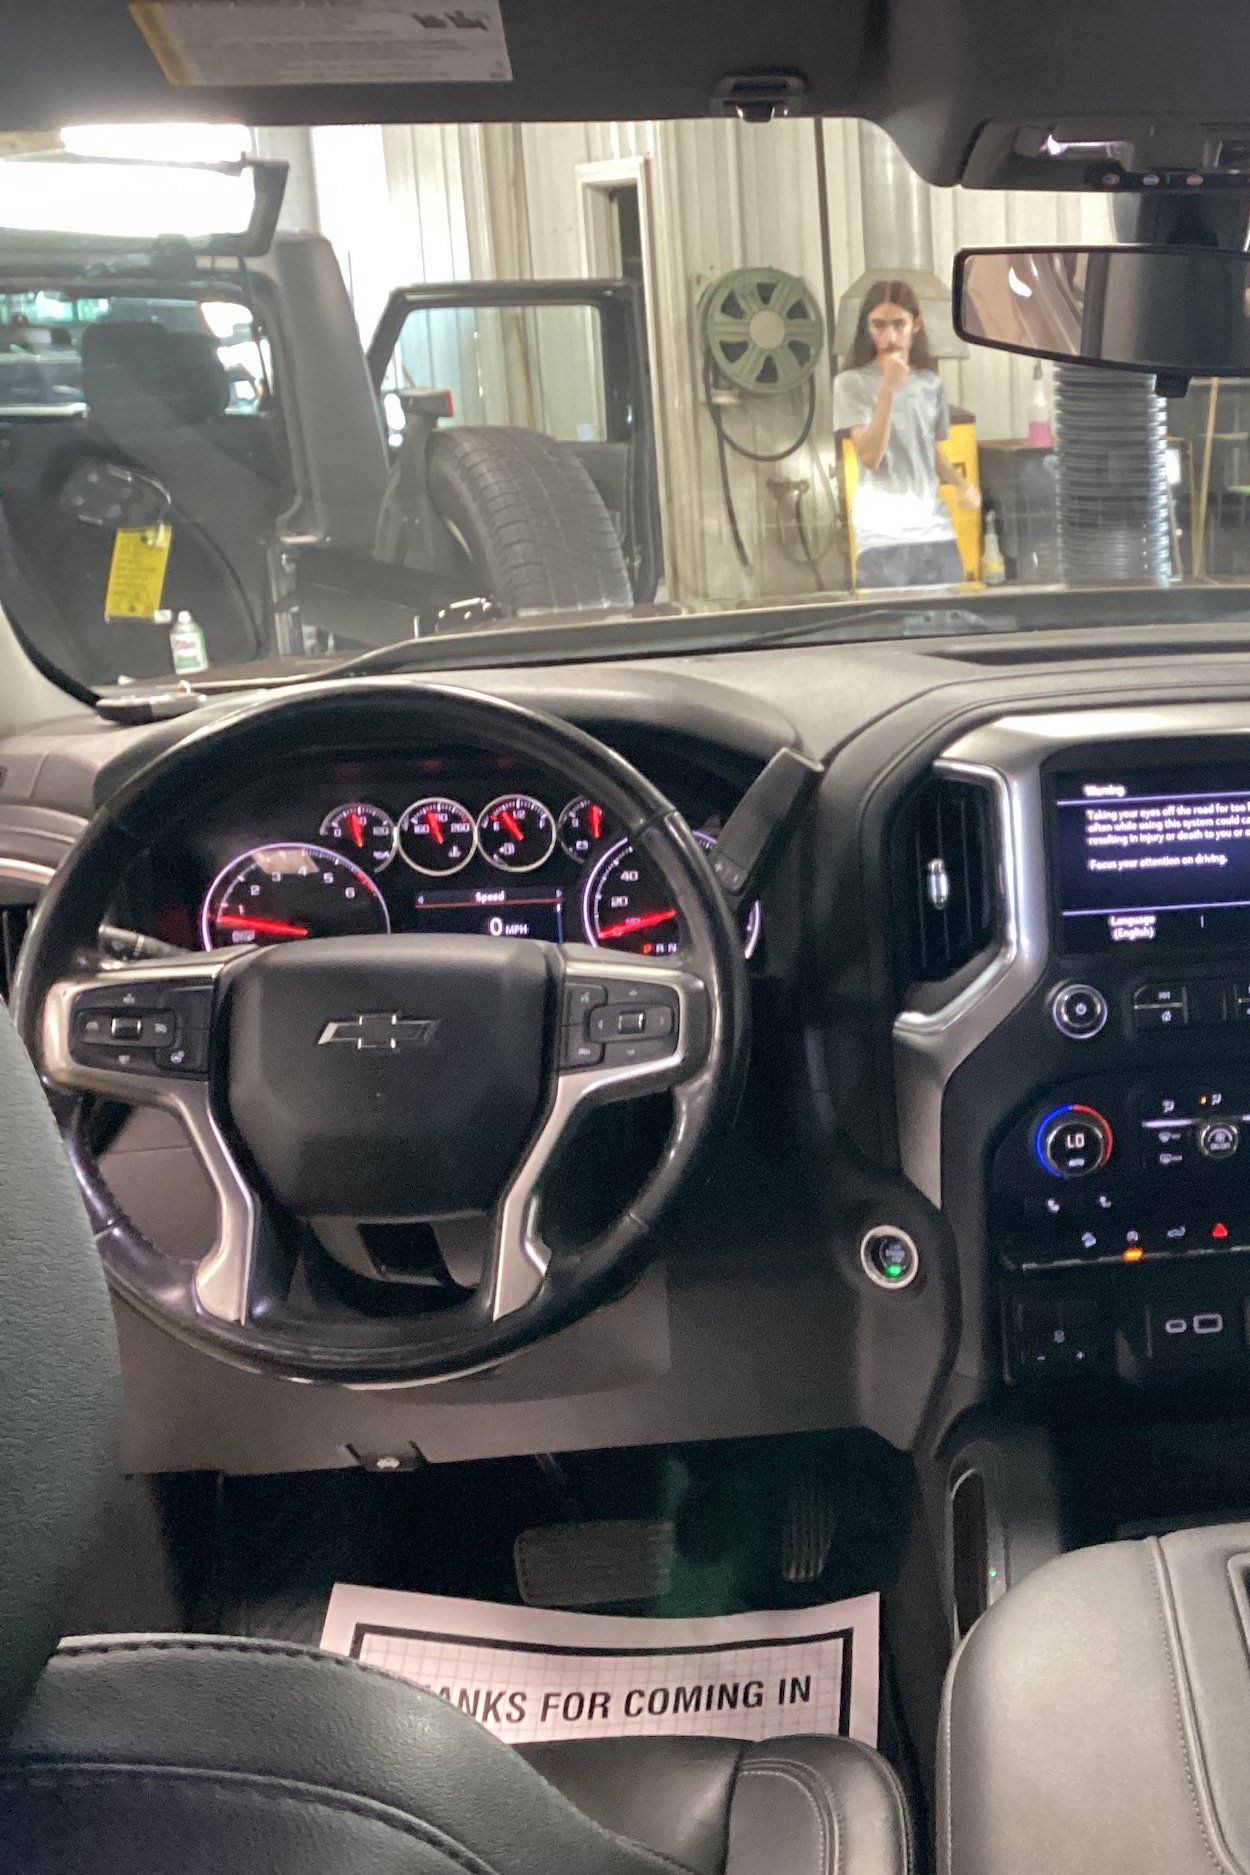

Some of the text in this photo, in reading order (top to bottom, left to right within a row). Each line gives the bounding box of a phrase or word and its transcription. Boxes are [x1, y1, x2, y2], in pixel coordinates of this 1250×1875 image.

[1086, 810, 1118, 821] Taking
[1118, 810, 1138, 820] your
[1140, 809, 1160, 819] eyes
[1162, 805, 1175, 816] off
[1176, 805, 1192, 815] the
[1194, 804, 1214, 814] road
[1215, 803, 1228, 813] for
[1230, 803, 1246, 812] too
[1087, 822, 1113, 833] often
[1114, 821, 1137, 831] while
[1139, 821, 1163, 831] using
[1164, 818, 1181, 828] this
[1182, 818, 1214, 829] system
[1216, 814, 1240, 825] could
[1088, 834, 1128, 846] resulting
[1129, 834, 1138, 843] in
[1140, 833, 1164, 844] injury
[1177, 830, 1203, 840] death
[1204, 830, 1214, 839] to
[1215, 830, 1232, 841] you
[1089, 854, 1228, 871] Focus your attention on driving.
[324, 872, 334, 884] 5
[620, 870, 638, 882] 40
[250, 884, 260, 896] 2
[345, 886, 356, 898] 6
[475, 890, 506, 904] Speed
[610, 896, 628, 908] 20
[489, 917, 528, 936] 0 MPH
[1112, 926, 1156, 940] (English)
[656, 944, 664, 953] R
[668, 943, 677, 952] N
[1067, 1133, 1085, 1148] LO
[540, 1691, 612, 1722] FOR
[624, 1680, 764, 1718] COMING
[778, 1675, 811, 1705] IN
